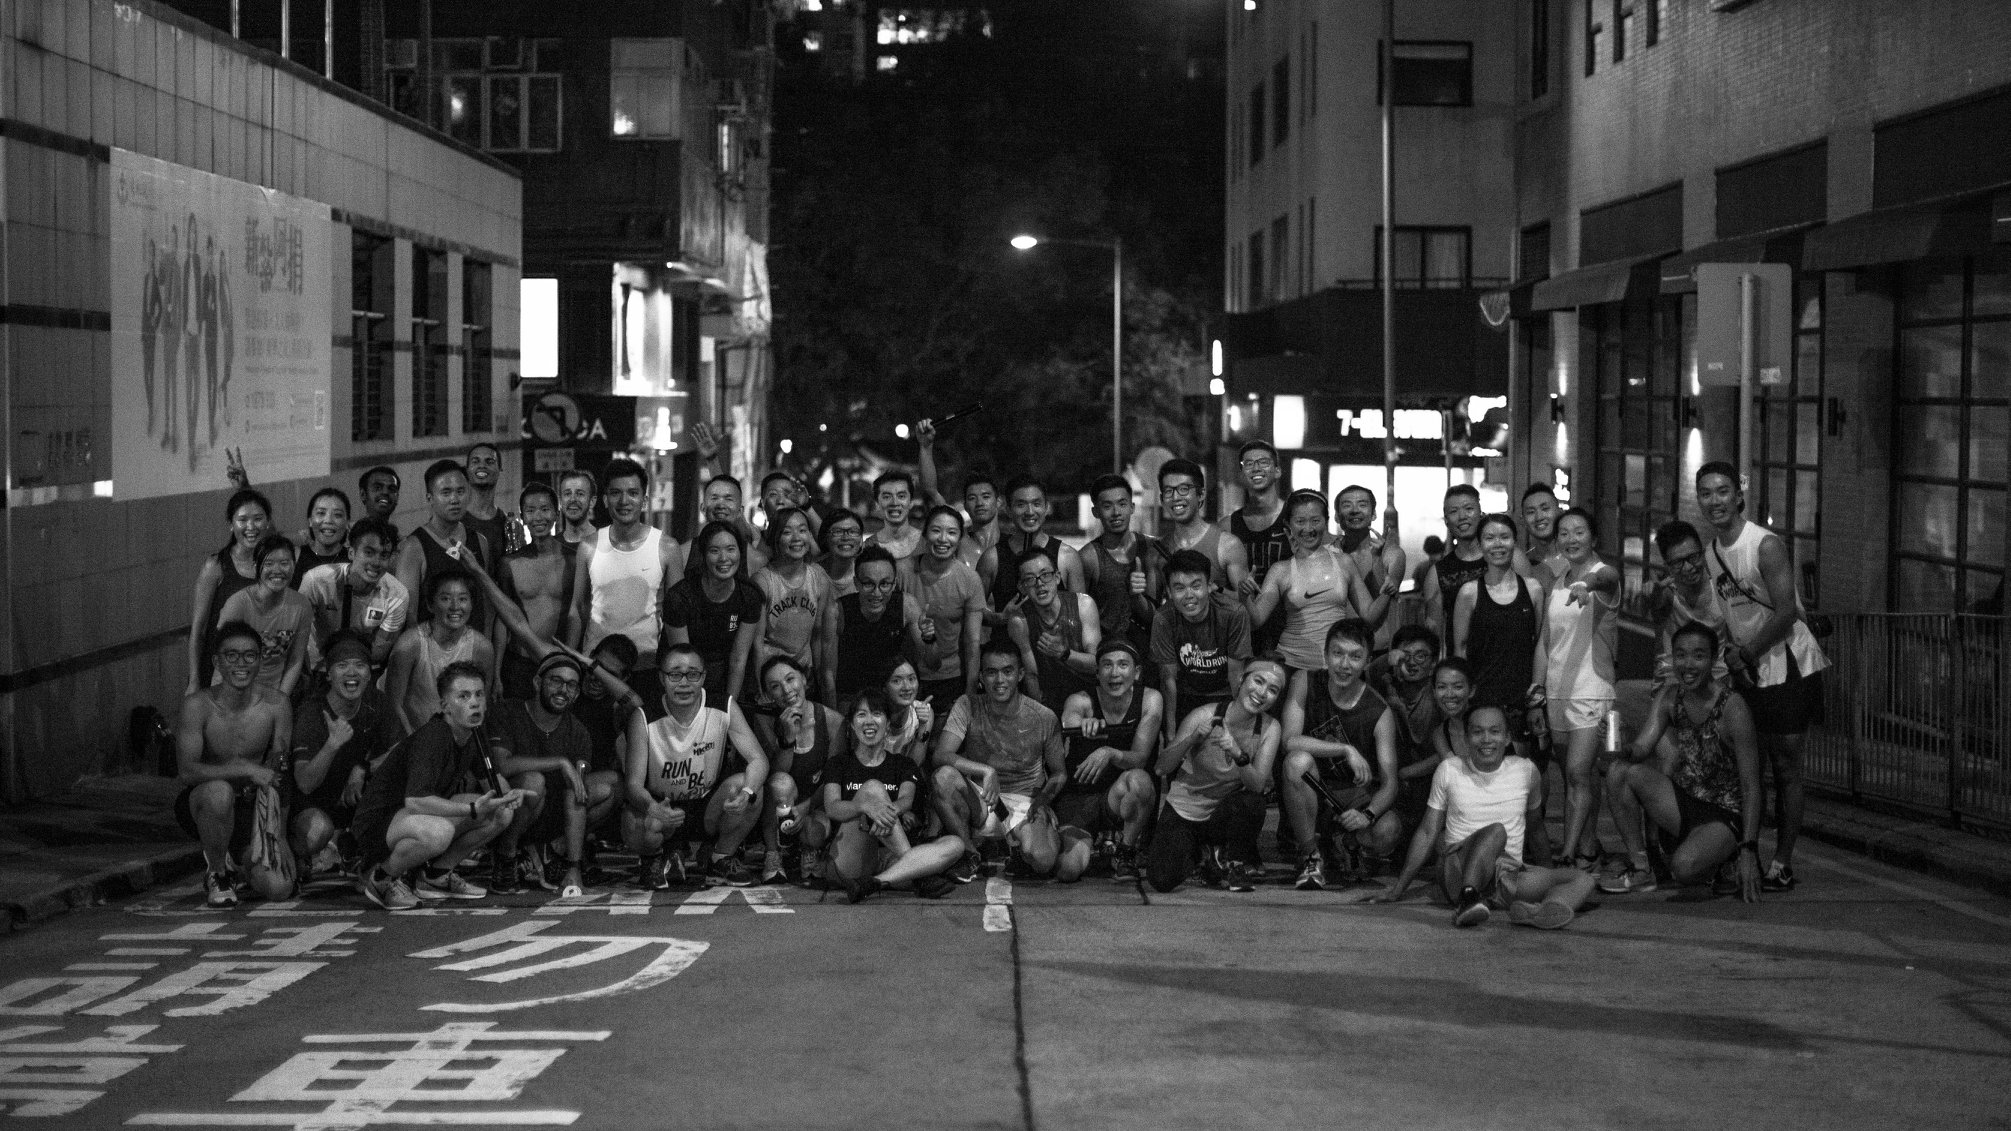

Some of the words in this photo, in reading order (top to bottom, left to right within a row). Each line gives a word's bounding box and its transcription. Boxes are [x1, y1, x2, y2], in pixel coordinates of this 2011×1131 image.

[769, 595, 798, 618] TRACK
[661, 757, 692, 779] RUN
[671, 778, 687, 786] AND
